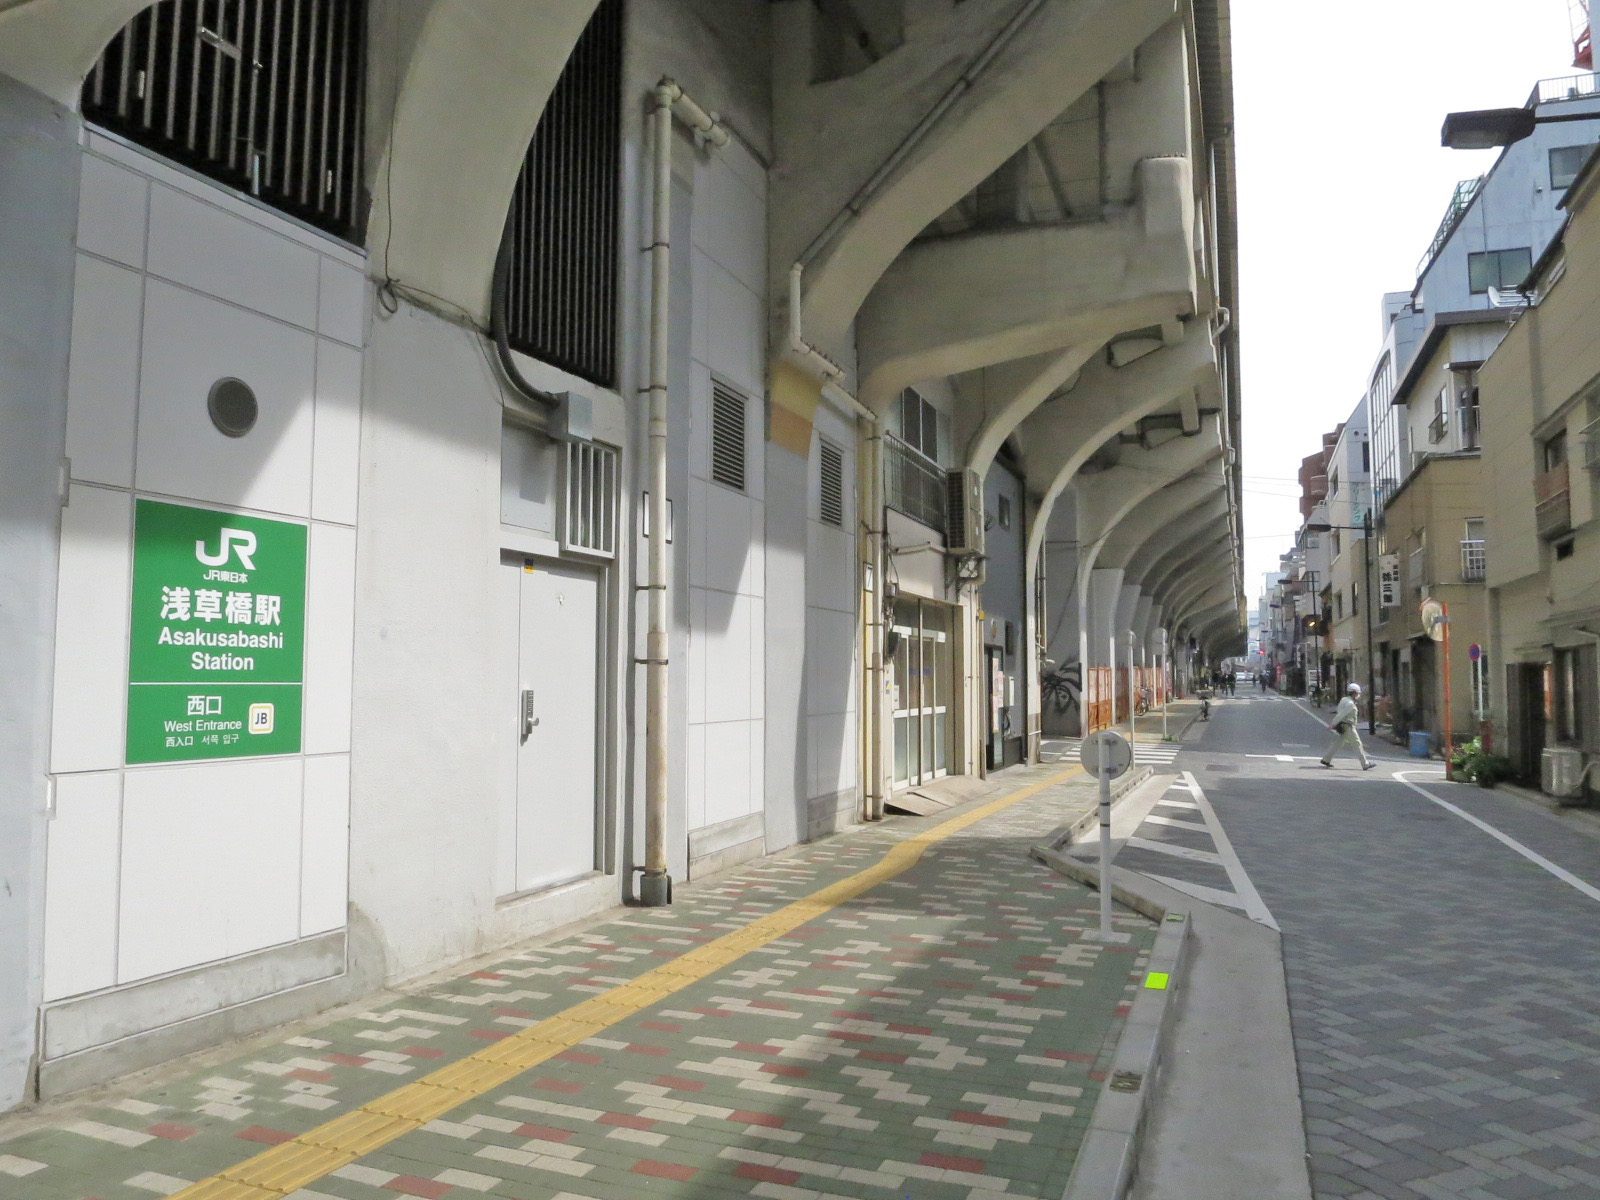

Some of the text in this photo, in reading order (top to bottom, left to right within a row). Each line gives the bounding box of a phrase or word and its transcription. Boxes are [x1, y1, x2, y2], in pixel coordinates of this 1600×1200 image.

[195, 527, 257, 570] JR
[203, 569, 249, 584] JR東日本
[160, 586, 281, 626] 浅草橋駅
[158, 626, 283, 649] Asakusabashi
[191, 651, 254, 671] Station
[187, 695, 222, 716] 西口
[164, 719, 242, 733] West Entrance
[254, 712, 268, 725] JB
[165, 735, 194, 748] 西入口
[201, 733, 240, 745] 서쪽 입구
